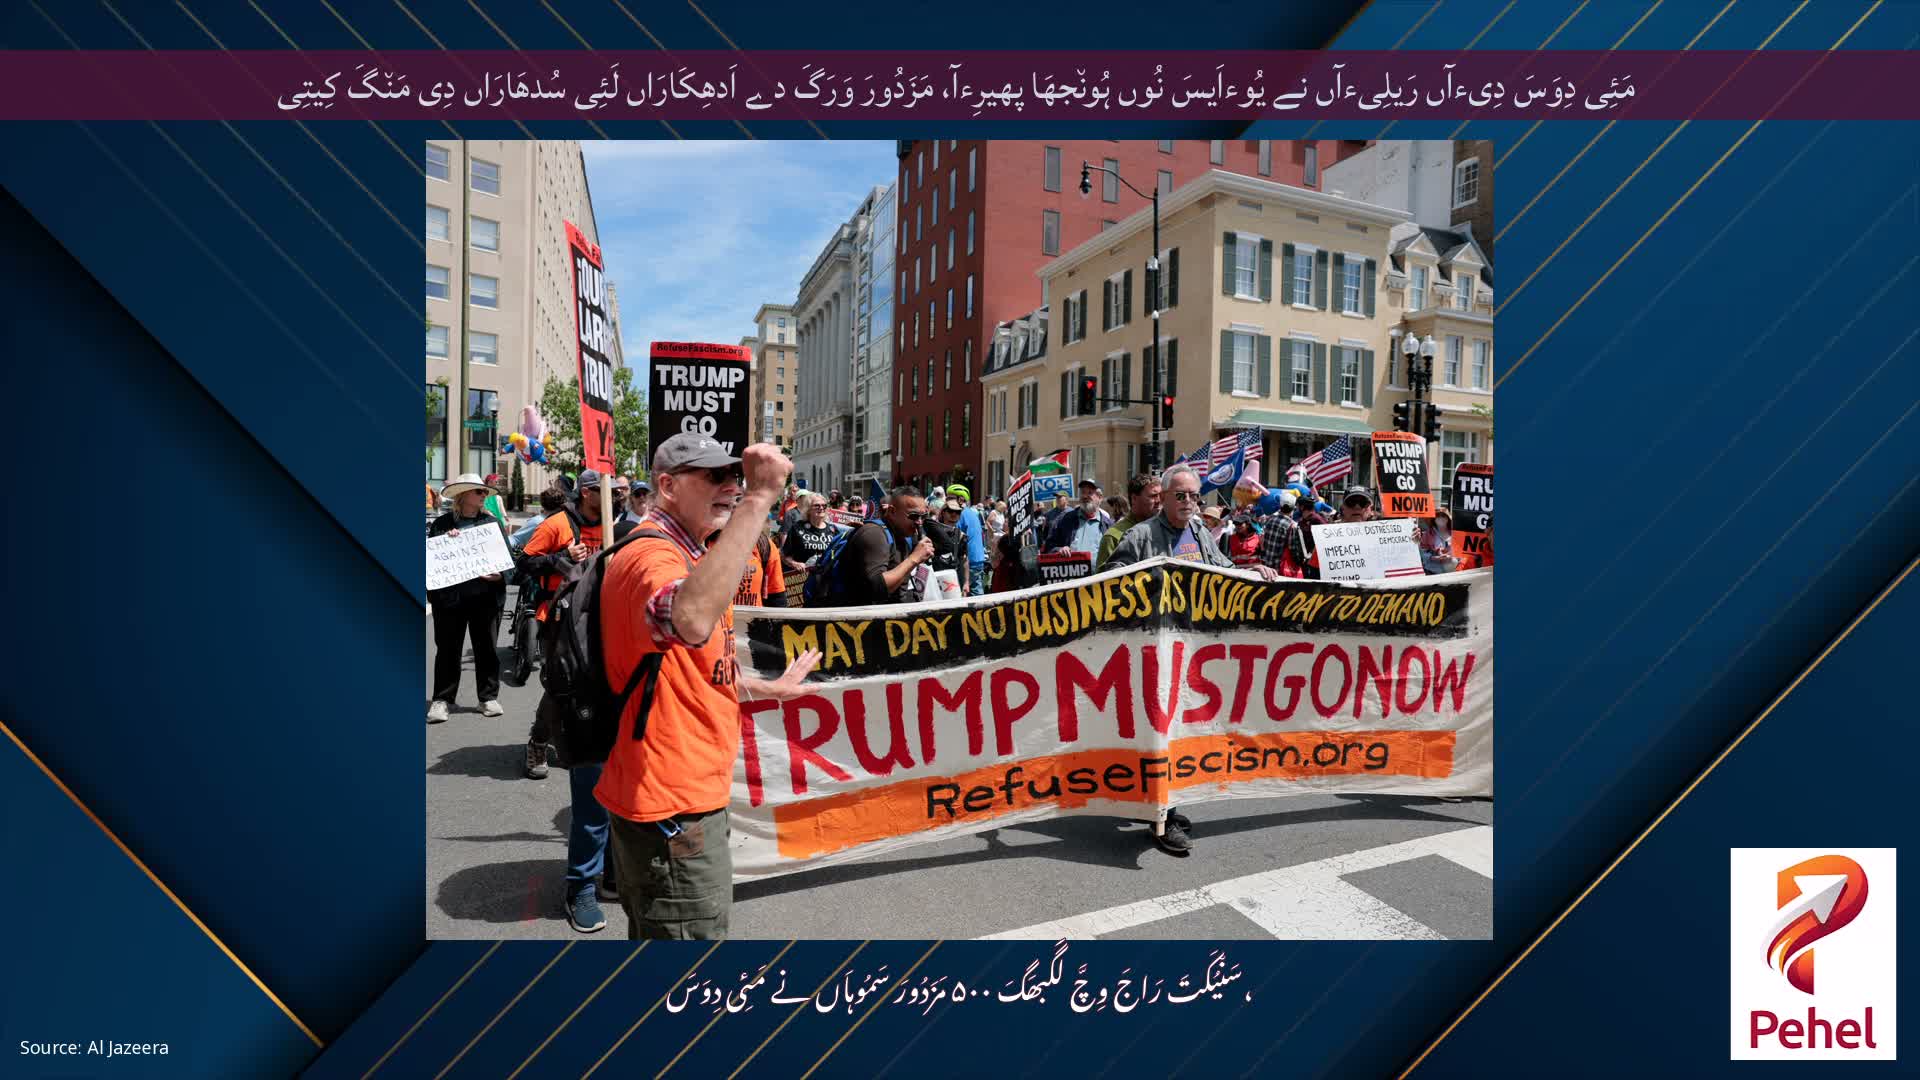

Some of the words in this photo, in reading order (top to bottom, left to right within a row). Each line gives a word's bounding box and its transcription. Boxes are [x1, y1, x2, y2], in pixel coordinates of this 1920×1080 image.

[655, 364, 745, 389] TRUMP
[664, 390, 736, 413] MUST
[680, 414, 718, 438] GO
[1375, 442, 1423, 459] TRUMP
[1382, 458, 1421, 475] MUST
[1035, 477, 1071, 492] NOPE
[1396, 475, 1416, 491] GO
[1008, 481, 1032, 506] TRUMP
[1011, 495, 1030, 516] MUST
[1391, 496, 1428, 512] NOW!
[1015, 508, 1027, 523] GO
[1324, 544, 1361, 557] IMPEACH
[1041, 563, 1089, 579] TRUMP
[1328, 558, 1367, 571] DICTATOR
[781, 618, 873, 672] MAY
[885, 615, 952, 657] DAY
[960, 606, 1007, 646] NO
[1014, 572, 1153, 642] BUSINESS
[1159, 571, 1186, 616] AS
[1189, 574, 1265, 623] USUAL
[1261, 592, 1286, 622] A
[1282, 592, 1330, 624] DAY
[1329, 594, 1362, 622] TO
[1357, 591, 1446, 626] DEMAND
[739, 668, 1040, 808] TRUMP
